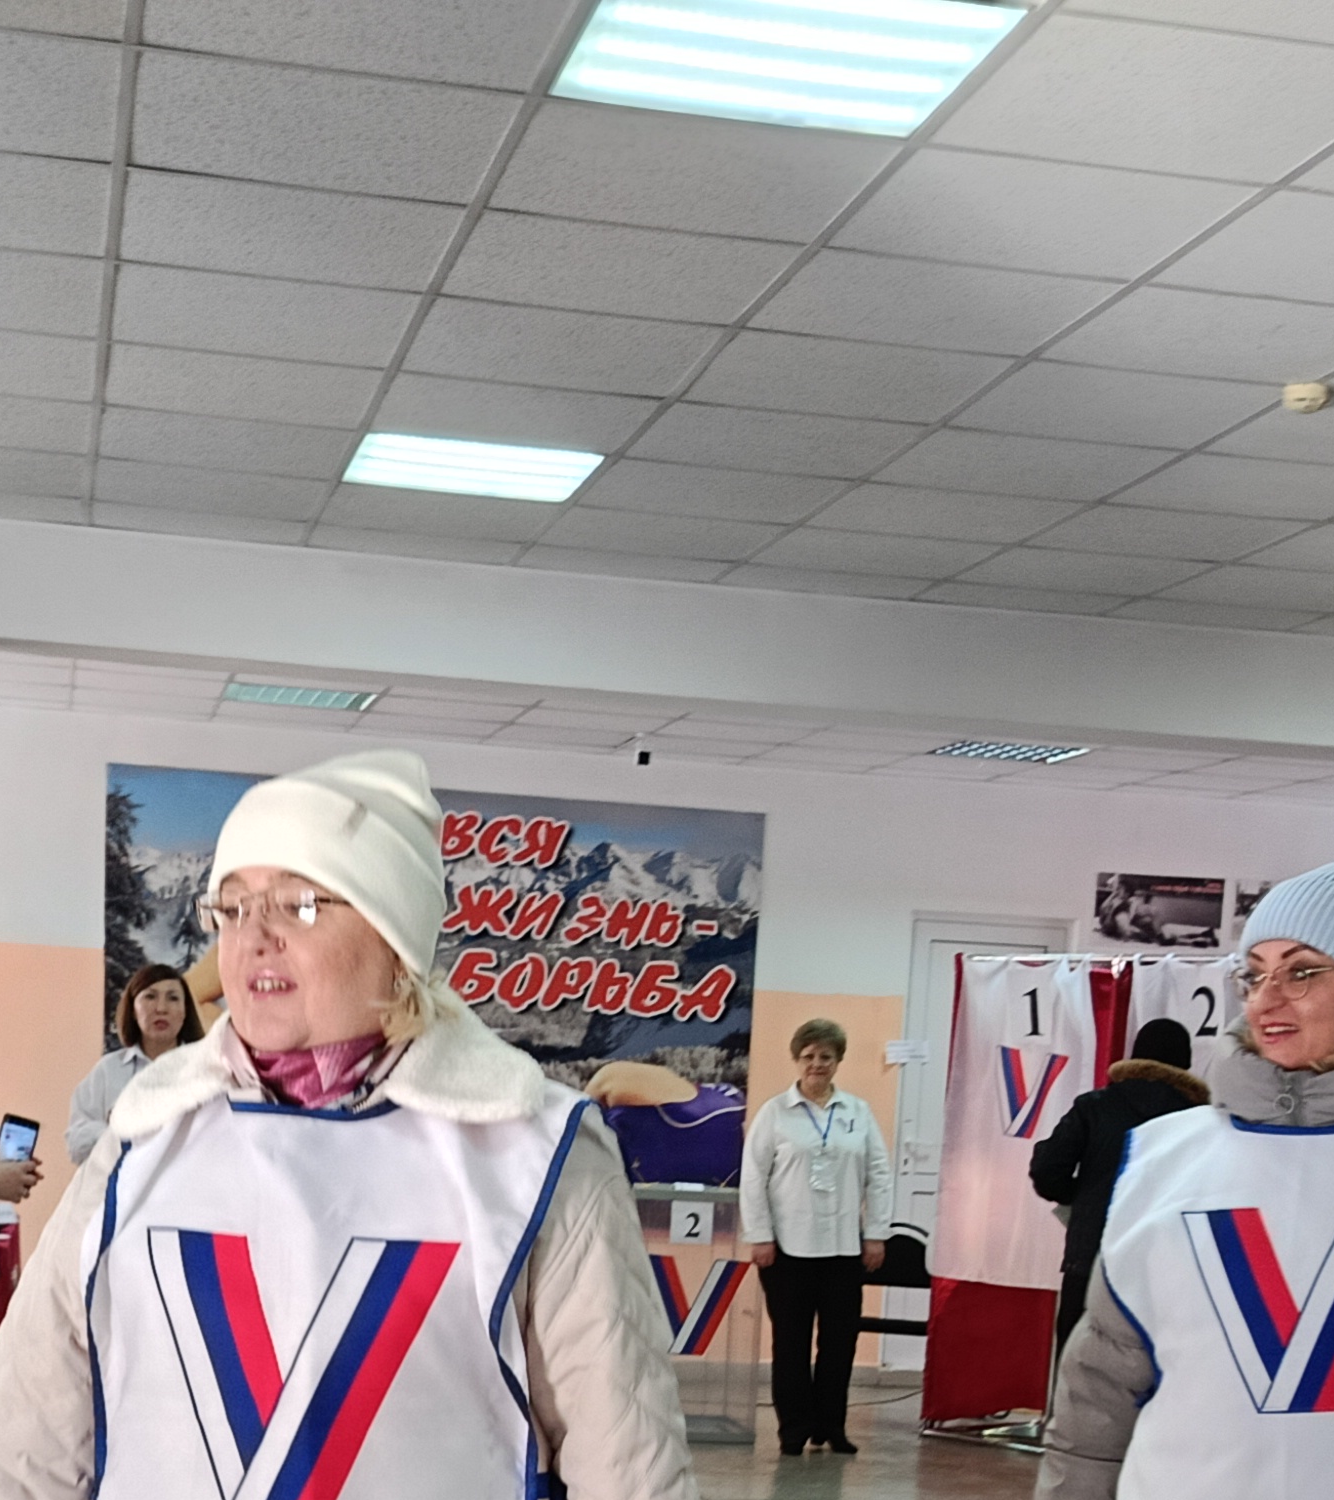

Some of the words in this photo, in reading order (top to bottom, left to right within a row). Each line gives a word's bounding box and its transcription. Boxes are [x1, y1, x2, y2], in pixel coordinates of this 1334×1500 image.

[441, 811, 568, 868] ВСЯ
[448, 948, 736, 1022] БОРЬБА
[1191, 985, 1219, 1037] 2
[1022, 987, 1044, 1037] 1
[684, 1212, 701, 1238] 2
